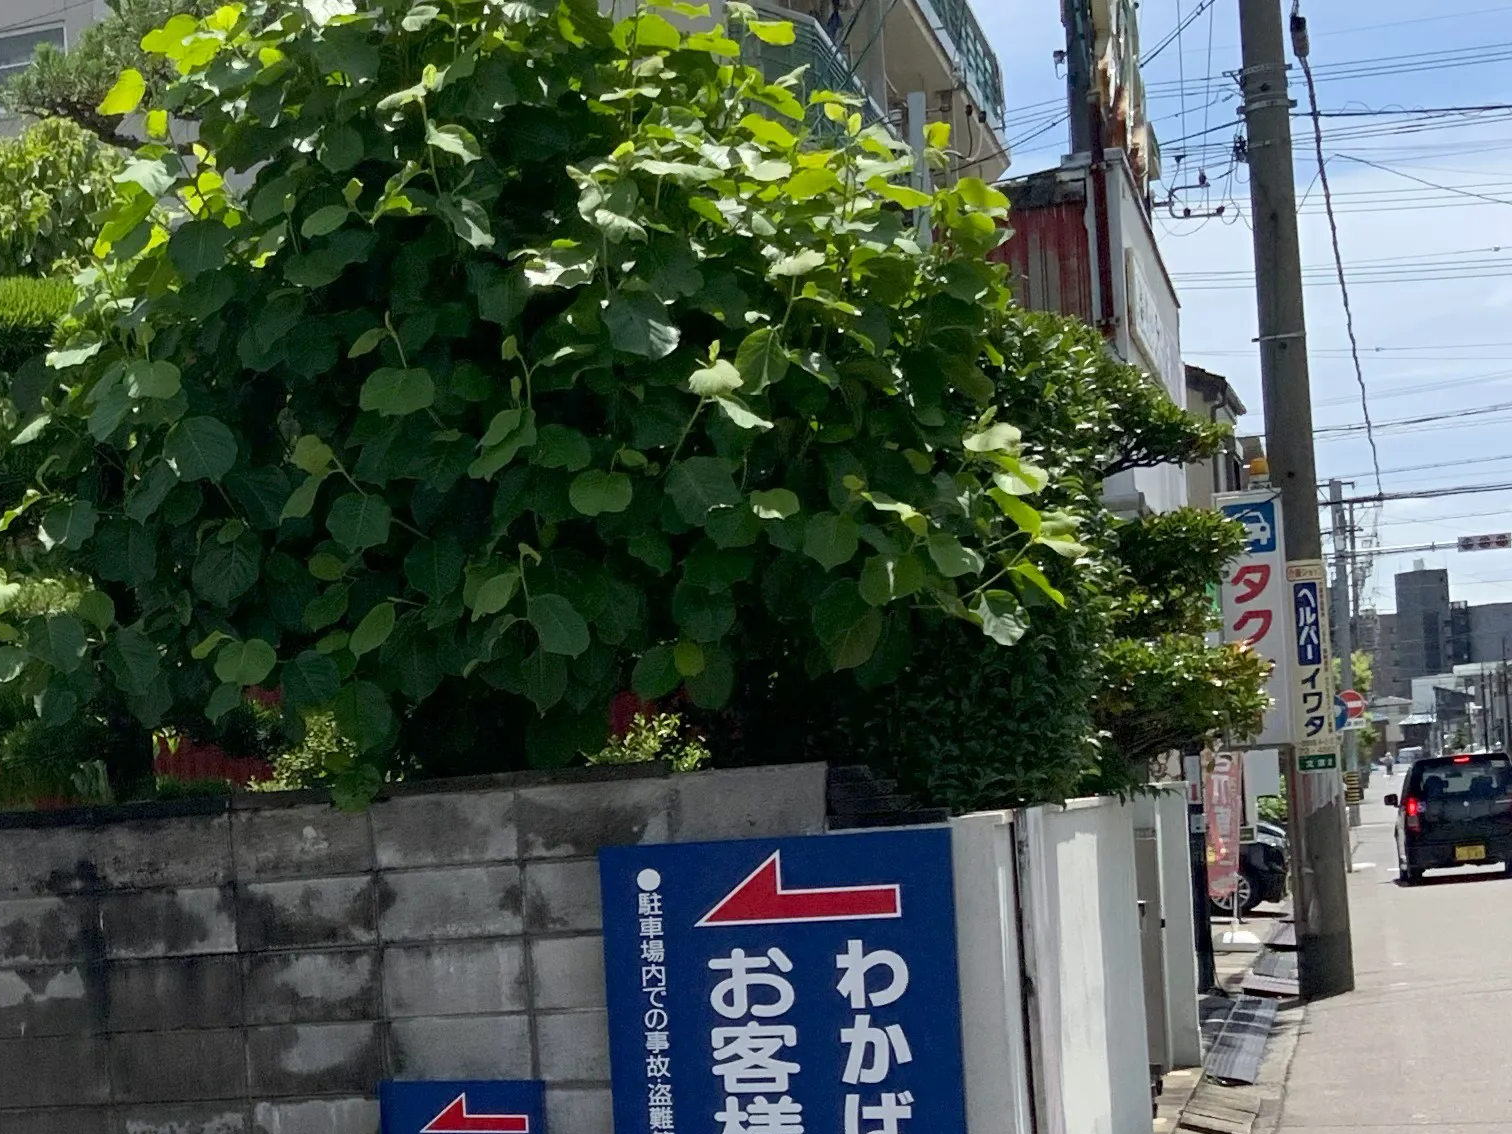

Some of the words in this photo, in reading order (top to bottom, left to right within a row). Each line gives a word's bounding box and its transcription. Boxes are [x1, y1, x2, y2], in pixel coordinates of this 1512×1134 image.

[1297, 588, 1319, 660] ヘルパー
[1301, 668, 1324, 737] イワタ
